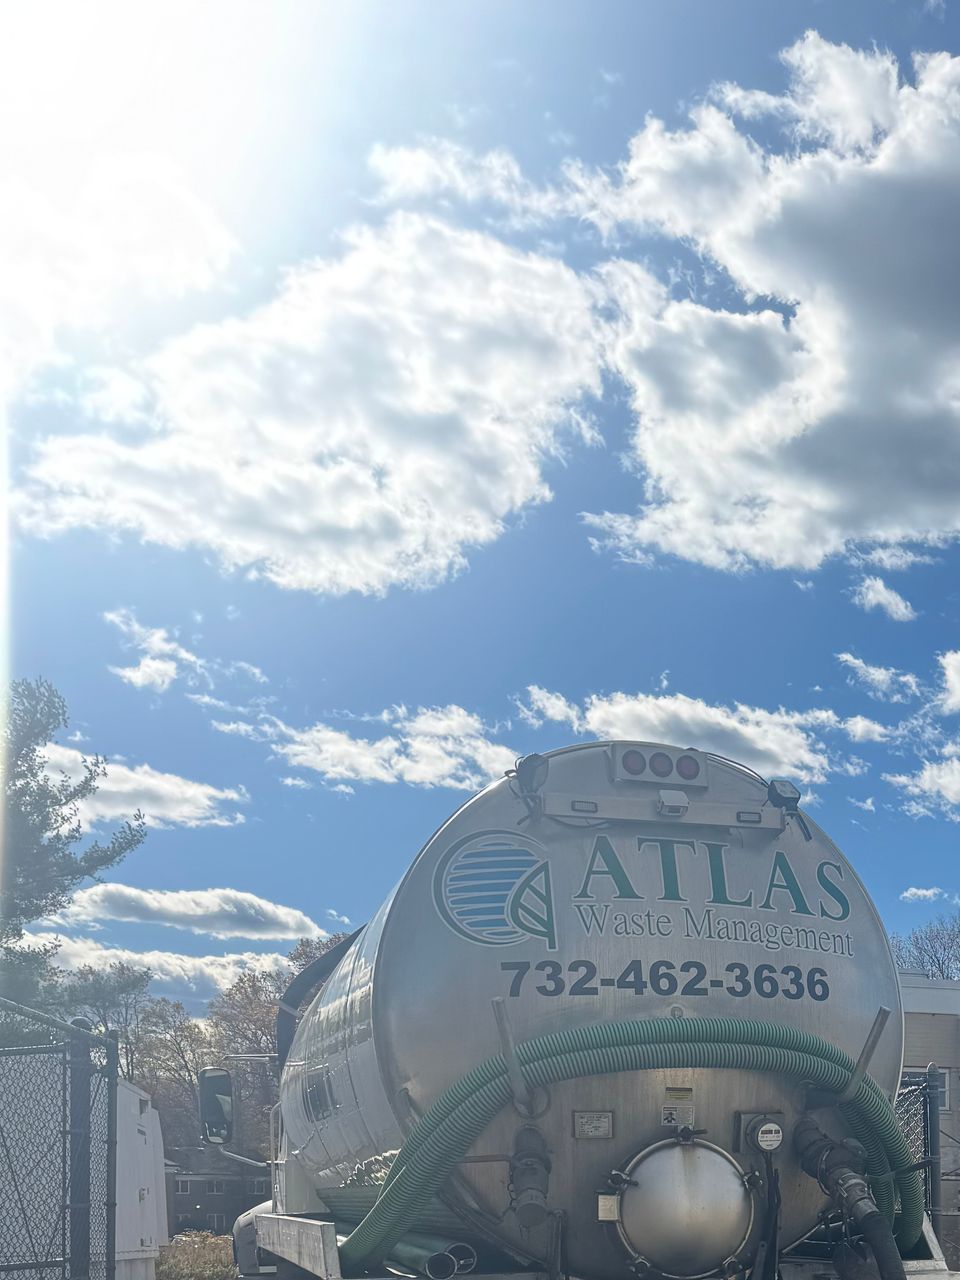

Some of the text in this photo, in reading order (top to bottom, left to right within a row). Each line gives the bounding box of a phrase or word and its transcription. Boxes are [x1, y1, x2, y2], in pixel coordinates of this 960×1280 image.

[572, 833, 851, 922] ATLAS
[572, 904, 855, 957] Waste Management
[500, 958, 830, 1002] 732-462-3636
